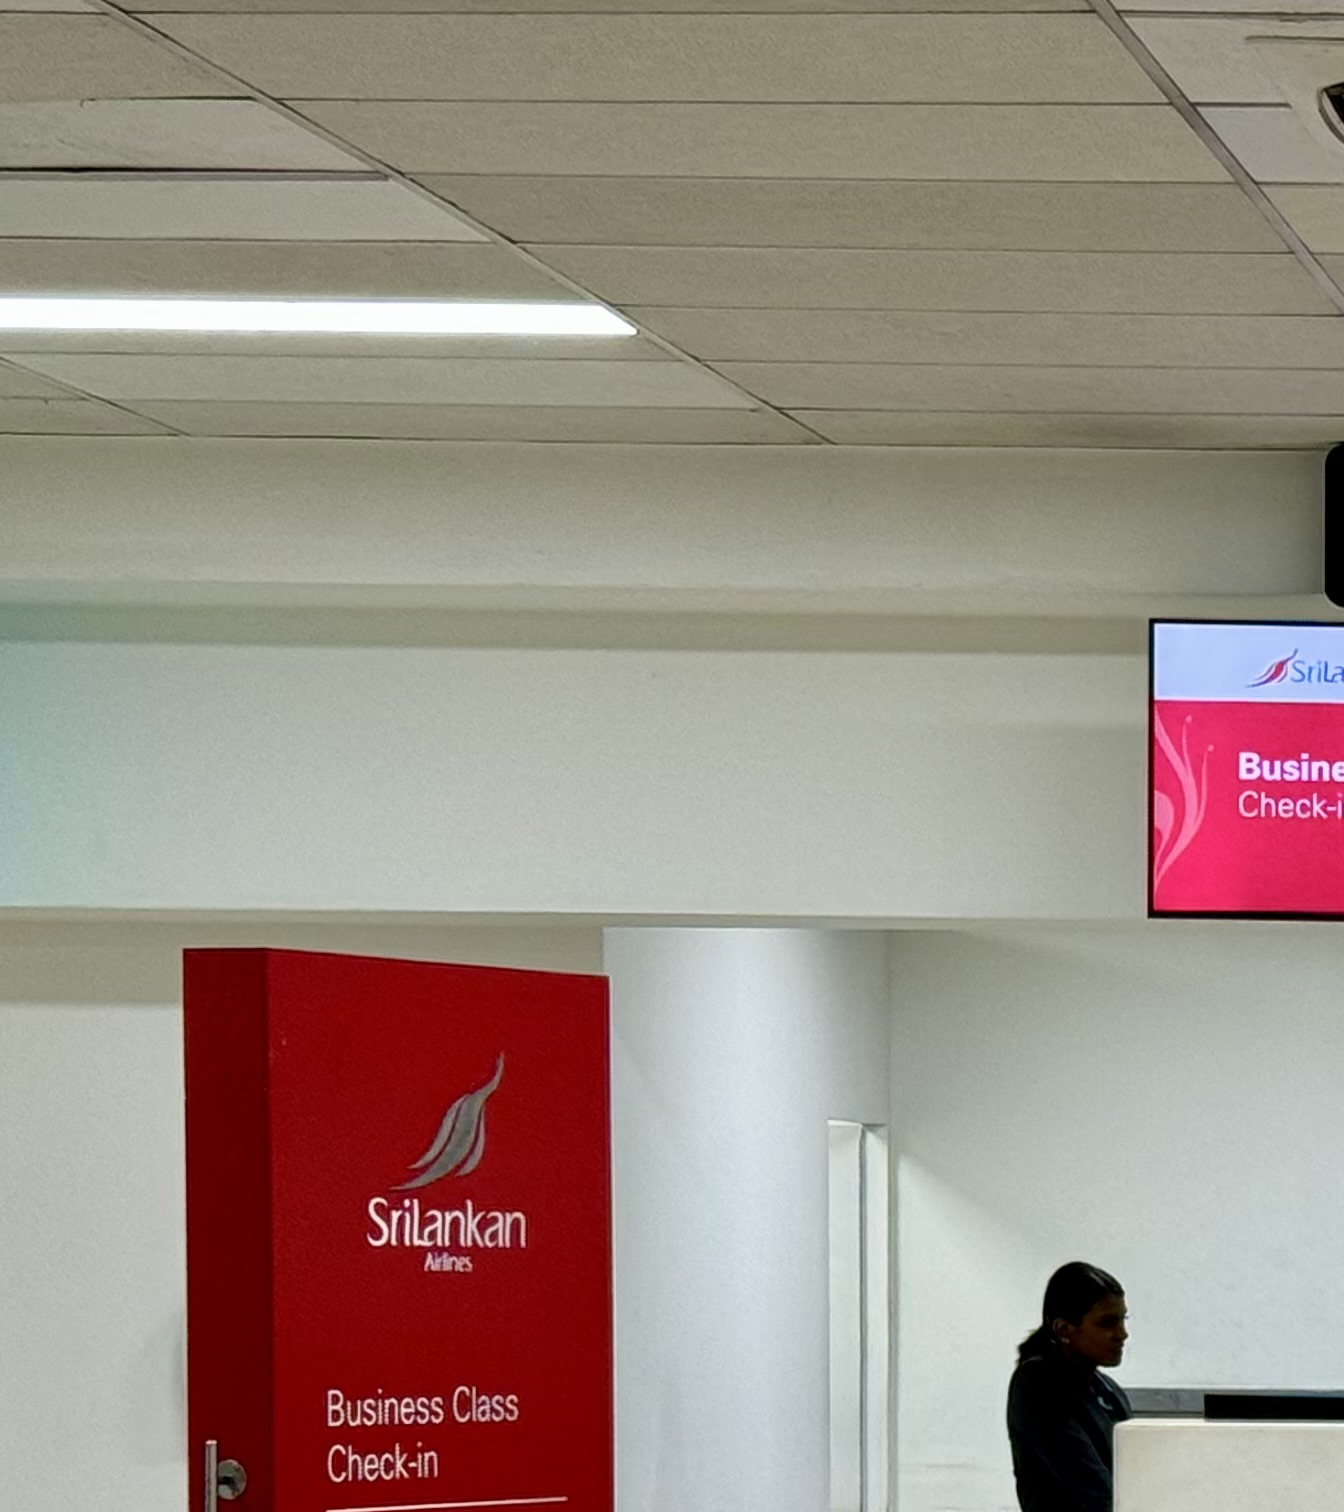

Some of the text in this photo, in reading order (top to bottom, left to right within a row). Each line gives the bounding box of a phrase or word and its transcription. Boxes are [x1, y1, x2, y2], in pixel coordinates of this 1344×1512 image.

[366, 1196, 527, 1249] SriLankan
[423, 1252, 474, 1273] Airlines
[326, 1386, 520, 1427] Business Class
[327, 1441, 439, 1483] Check-in
